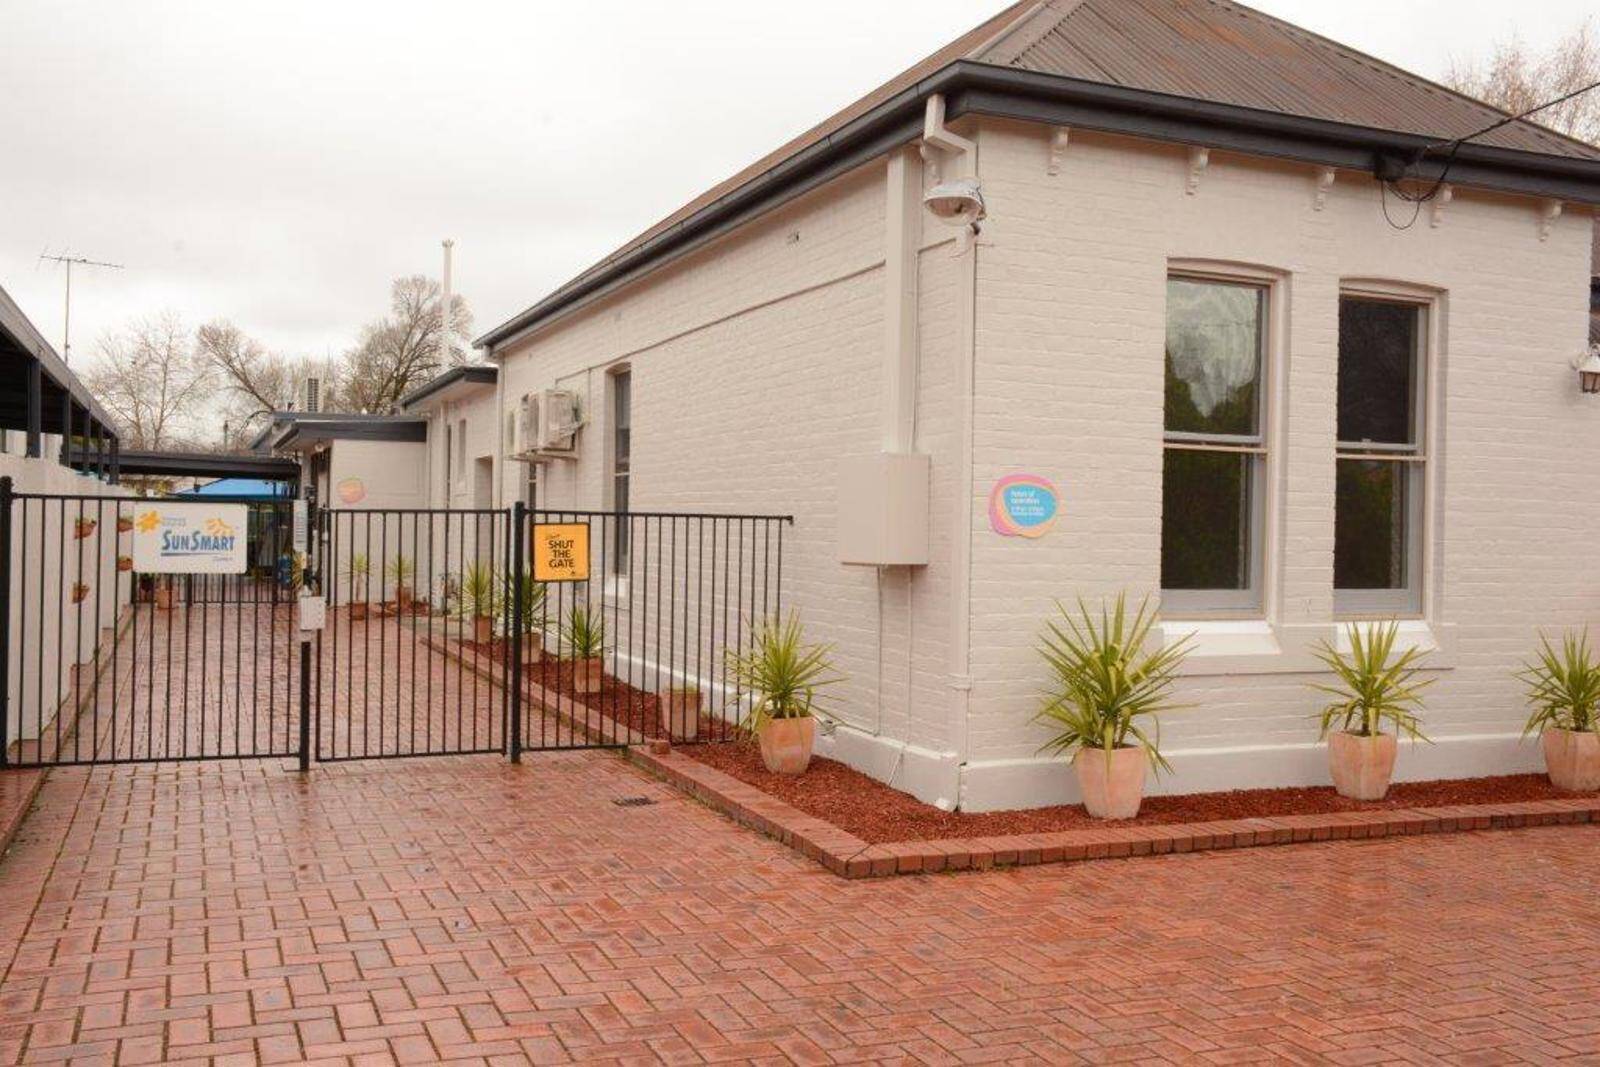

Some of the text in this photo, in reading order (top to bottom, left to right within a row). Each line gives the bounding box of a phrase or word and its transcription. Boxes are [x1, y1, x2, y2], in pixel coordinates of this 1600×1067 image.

[548, 539, 575, 549] SHUT
[552, 549, 571, 558] THE
[548, 559, 575, 568] GATE
